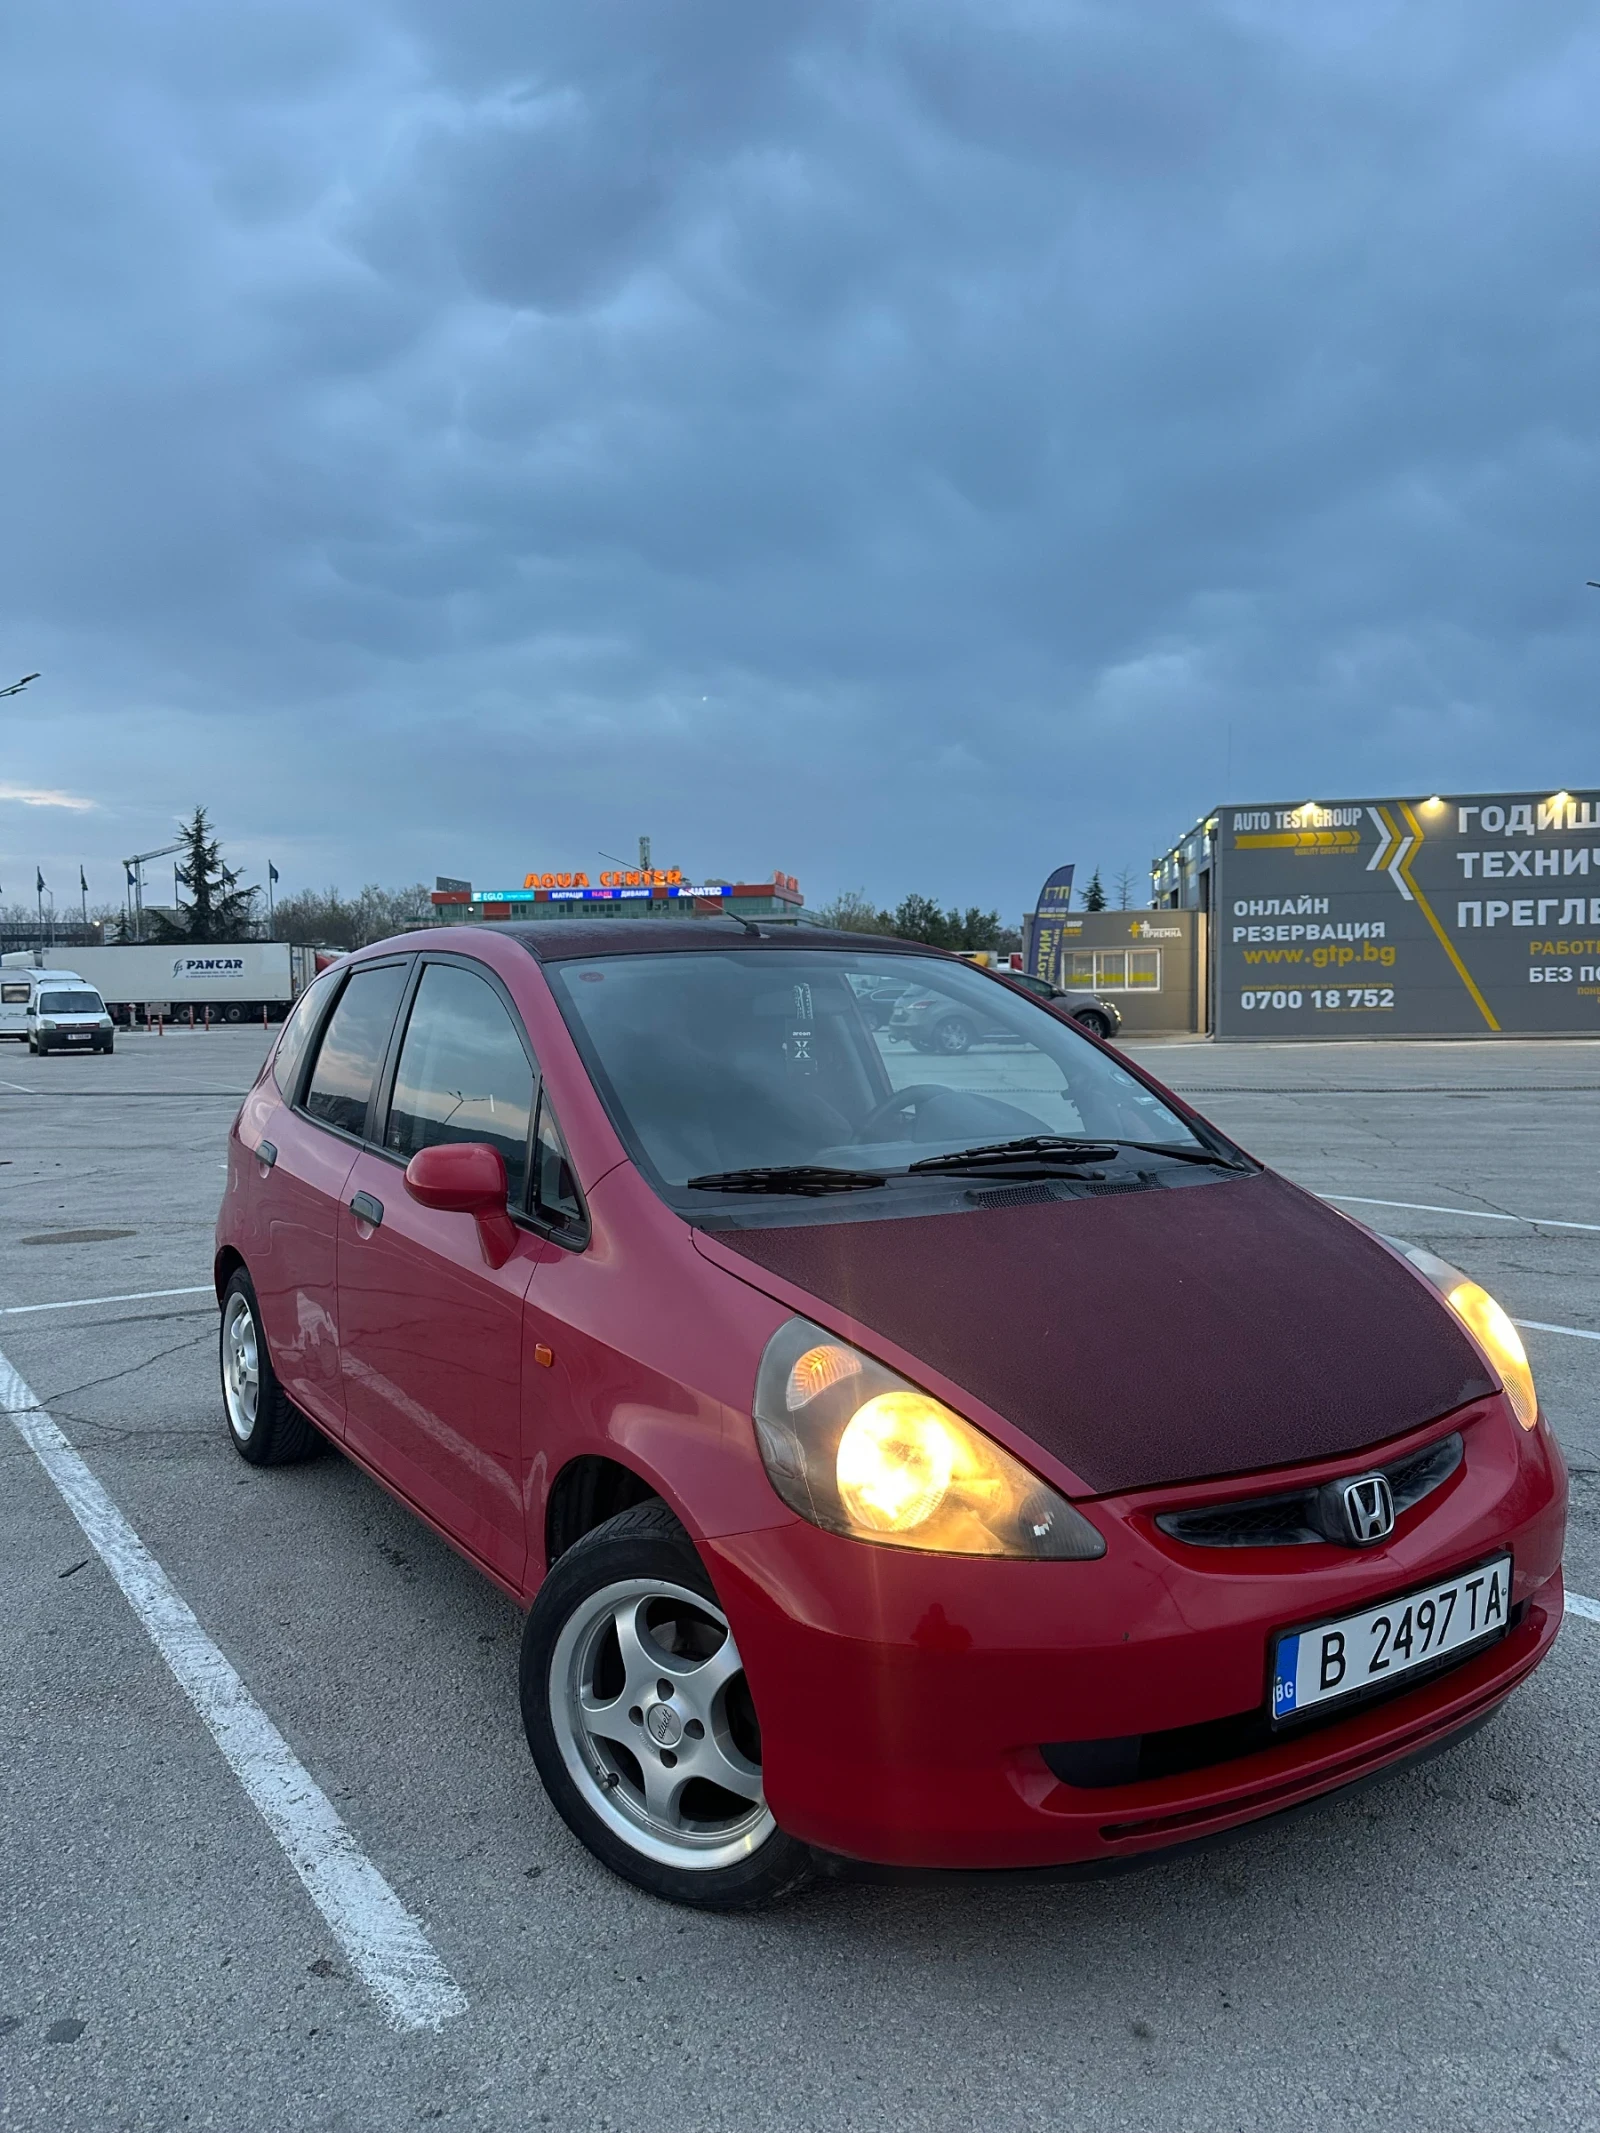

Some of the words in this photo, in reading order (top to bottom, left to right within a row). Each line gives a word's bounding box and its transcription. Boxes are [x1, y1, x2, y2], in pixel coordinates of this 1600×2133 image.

[1233, 812, 1270, 831] AUTO
[1275, 809, 1309, 829] TEST
[1313, 808, 1362, 828] GROUP
[1458, 802, 1600, 836] ГОДИШ
[523, 873, 590, 888] AQUA
[600, 870, 682, 887] CENTER
[482, 892, 504, 901] EGLO
[1233, 895, 1329, 916] ОНЛАЙН
[1142, 929, 1183, 939] ПРИЕМНА
[1233, 922, 1386, 943] РЕЗЕРВАЦИЯ
[1243, 941, 1397, 968] www.gtp.bg
[1529, 939, 1600, 955] РАБОТ
[186, 959, 243, 970] PANCAR
[1529, 966, 1573, 983] БЕЗ
[1580, 966, 1600, 982] П
[1241, 991, 1303, 1010] 0700
[1310, 990, 1341, 1009] 18
[1347, 988, 1395, 1008] 752
[1319, 1631, 1347, 1692] B
[1367, 1588, 1458, 1674] 2497
[1465, 1570, 1502, 1632] TA
[1274, 1681, 1295, 1703] BG
